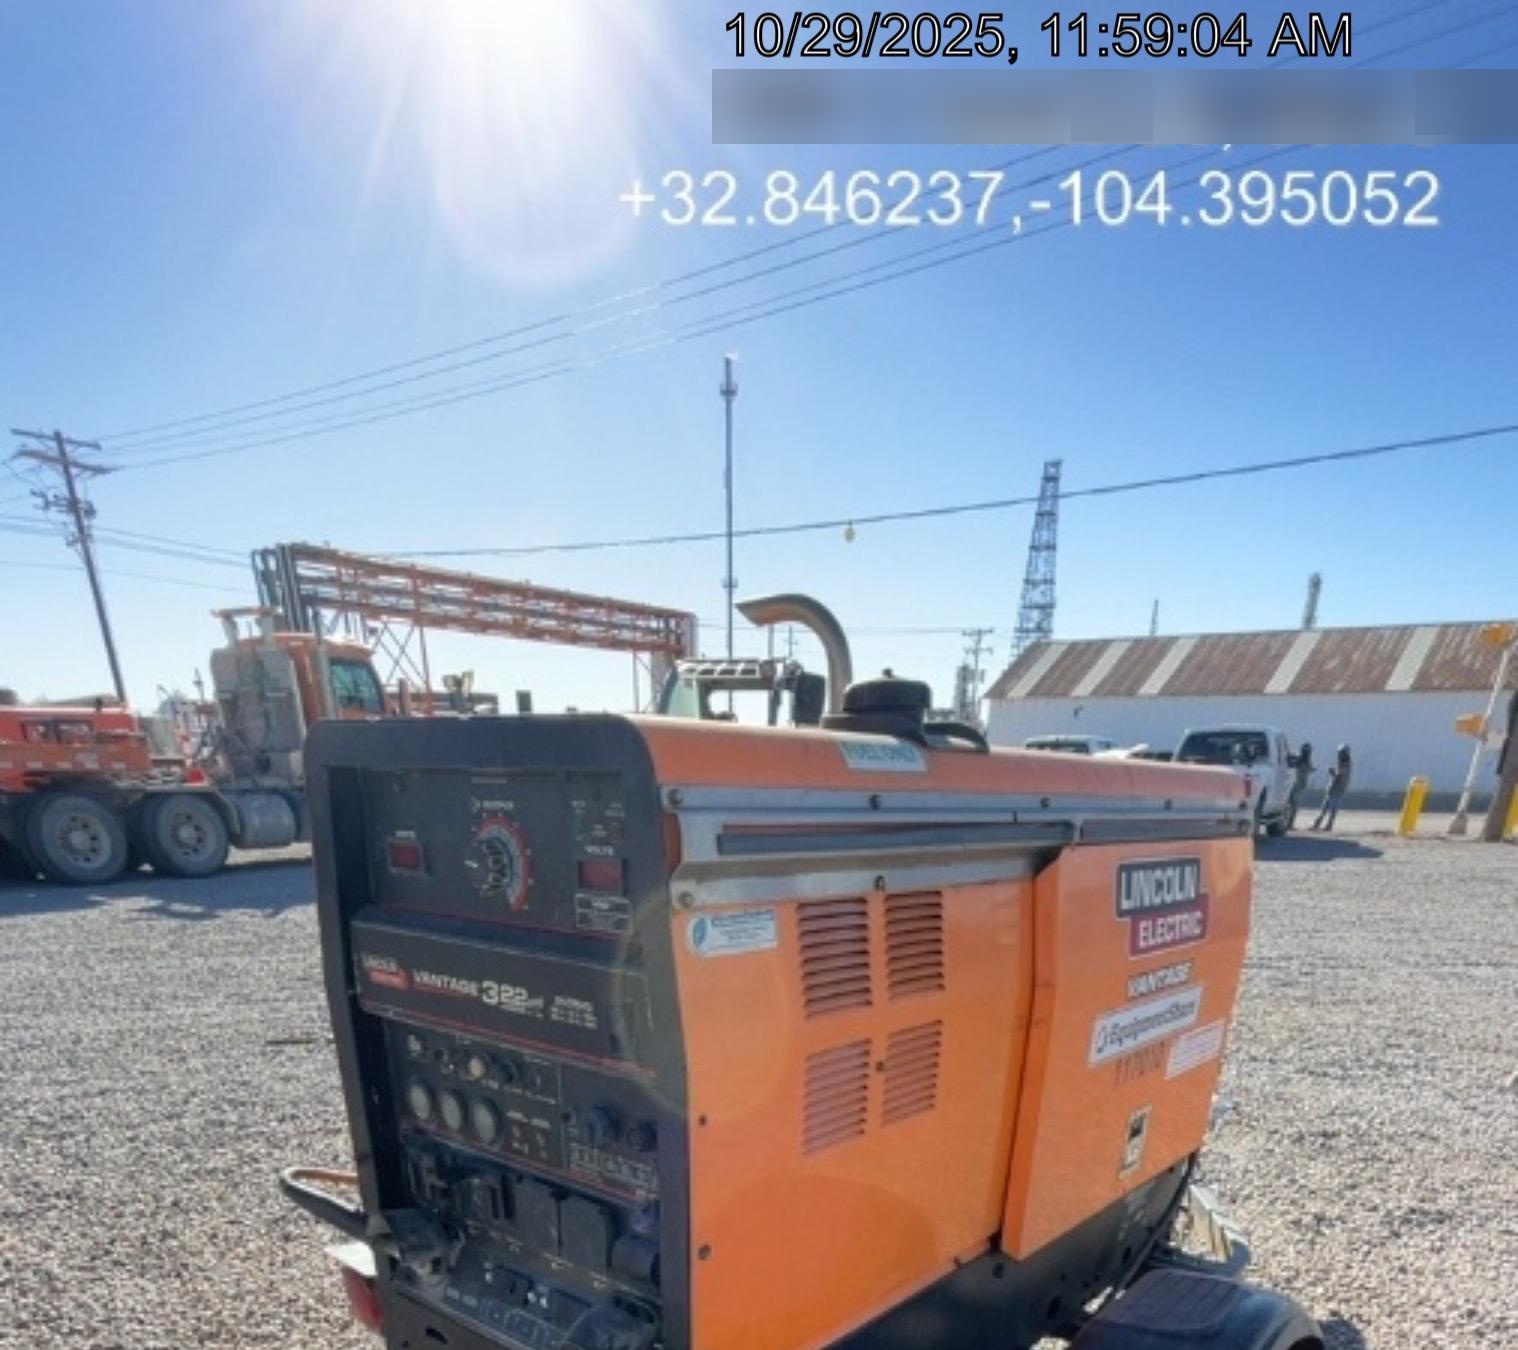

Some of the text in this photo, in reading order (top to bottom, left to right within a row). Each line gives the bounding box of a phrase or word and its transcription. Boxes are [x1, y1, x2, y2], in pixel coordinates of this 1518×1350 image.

[1120, 862, 1198, 911] LINCOLN
[1138, 911, 1203, 948] ELECTRIC
[413, 968, 479, 997] VANTAGE
[482, 980, 529, 1007] 322
